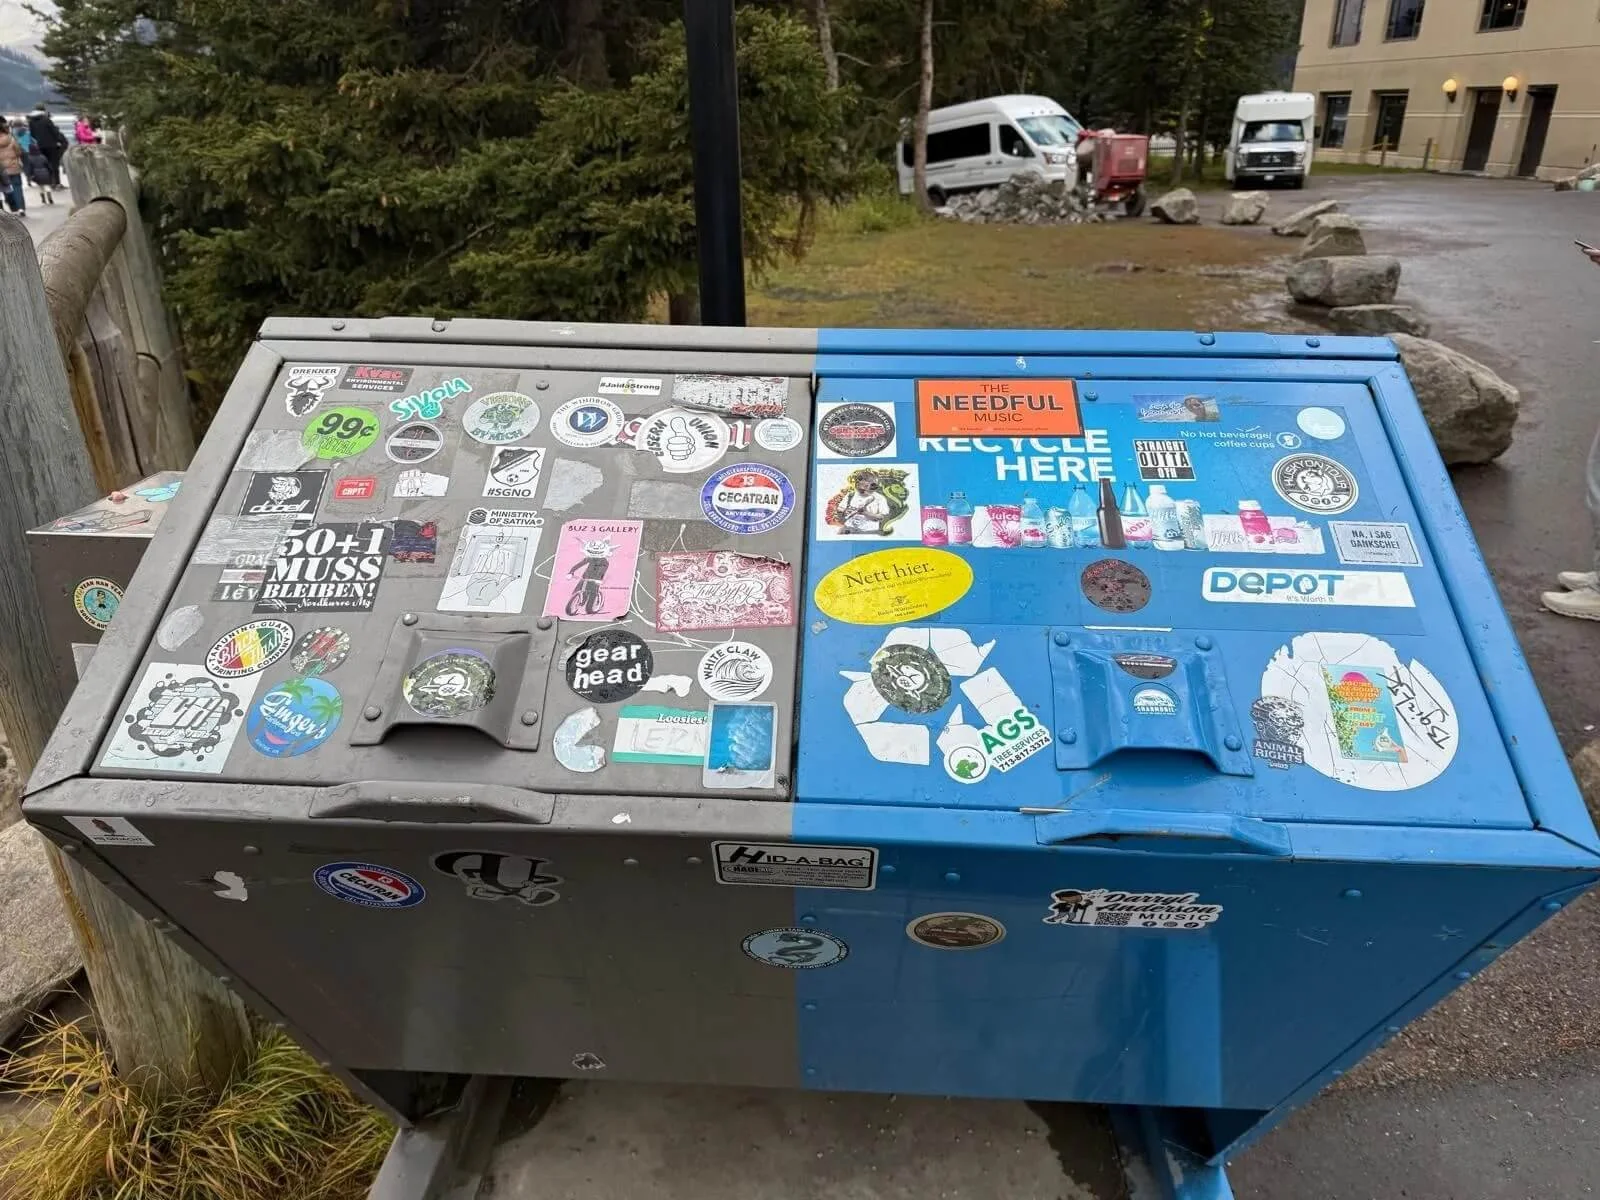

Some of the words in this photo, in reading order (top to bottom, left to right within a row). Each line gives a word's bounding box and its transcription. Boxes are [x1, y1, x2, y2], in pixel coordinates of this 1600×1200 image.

[346, 378, 404, 386] ENVIRONMENTAL
[981, 384, 1009, 392] THE
[932, 395, 1064, 411] NEEDFUL
[316, 412, 377, 439] 99¢
[974, 413, 1023, 422] MUSIC
[649, 419, 668, 458] EISERN
[689, 418, 720, 449] UNION
[1180, 430, 1196, 438] No
[1135, 440, 1186, 452] STRAIGHT
[1214, 440, 1247, 448] coffee
[1139, 452, 1189, 467] OUTTA
[996, 456, 1116, 483] HERE
[1284, 460, 1305, 487] HUSKY
[1325, 465, 1348, 489] TOUR
[487, 487, 532, 497] #SGNO
[718, 491, 779, 505] CECATRAN
[1125, 519, 1152, 535] SODA
[1375, 530, 1392, 539] SAG
[278, 528, 385, 556] 50+1
[267, 556, 383, 582] MUSS
[843, 571, 891, 589] Nett
[893, 562, 935, 578] hier.
[261, 582, 377, 599] BLEIBEN!
[79, 608, 96, 626] SOUTH
[260, 621, 289, 634] GUAM
[213, 665, 255, 677] PRINTING
[257, 638, 290, 669] COMPANY
[575, 644, 641, 668] gear
[704, 648, 726, 680] WHITE
[726, 645, 761, 661] CLAW
[573, 664, 643, 690] head
[259, 691, 327, 740] Ginger's
[655, 712, 708, 725] Loosies!
[981, 708, 1035, 755] AGS
[992, 750, 1014, 764] TREE
[1011, 729, 1047, 753] SERVICES
[998, 736, 1051, 771] 713-817-3374
[1255, 740, 1302, 755] ANIMAL
[1254, 748, 1303, 765] RIGHTS
[729, 846, 864, 866] HID-A-BAG
[339, 872, 401, 900] CECATRAN
[1102, 893, 1195, 905] Darryl
[1095, 902, 1218, 914] Anderson
[1138, 912, 1210, 921] MUSIC
